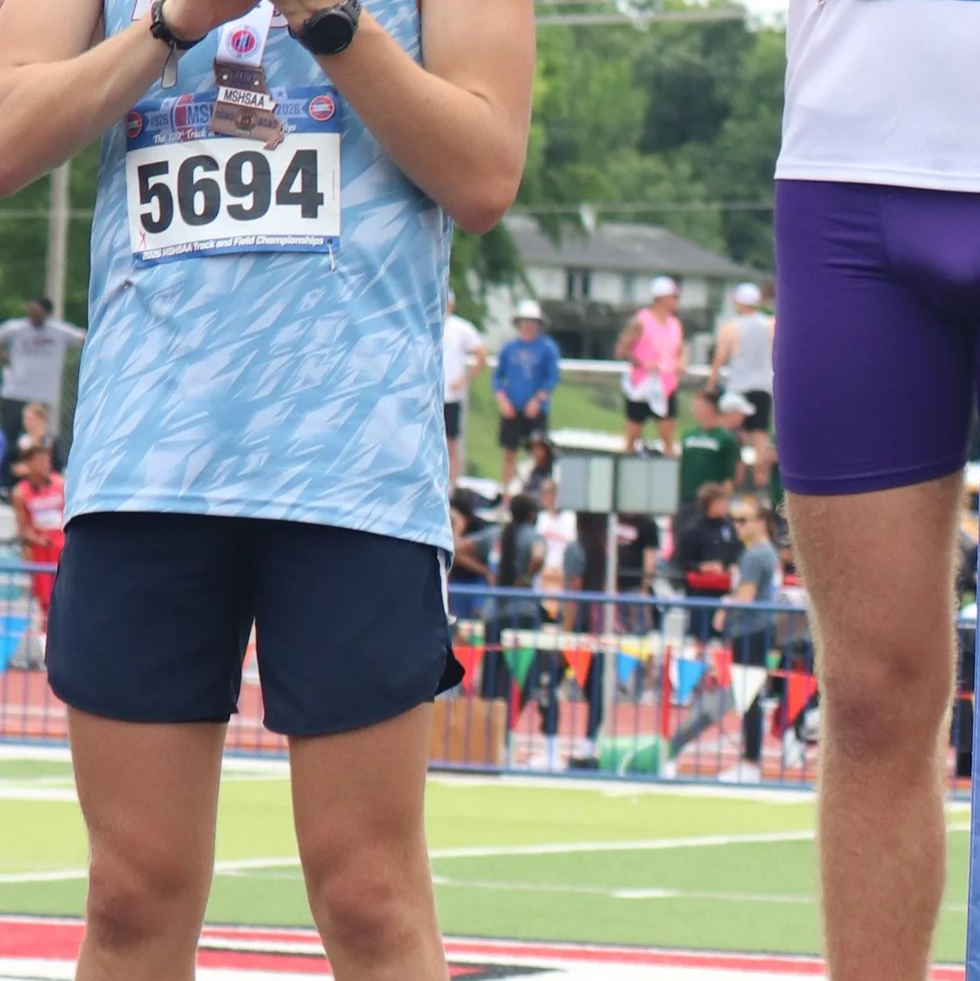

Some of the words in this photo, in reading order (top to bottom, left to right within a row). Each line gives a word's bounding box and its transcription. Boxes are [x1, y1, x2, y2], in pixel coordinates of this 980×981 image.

[223, 88, 266, 108] MSHSAA
[186, 127, 208, 139] Track
[137, 149, 325, 234] 5694
[161, 243, 193, 257] MSHSAA
[192, 240, 216, 251] Track
[215, 237, 233, 248] and
[232, 235, 256, 248] Field
[255, 234, 325, 247] Championships
